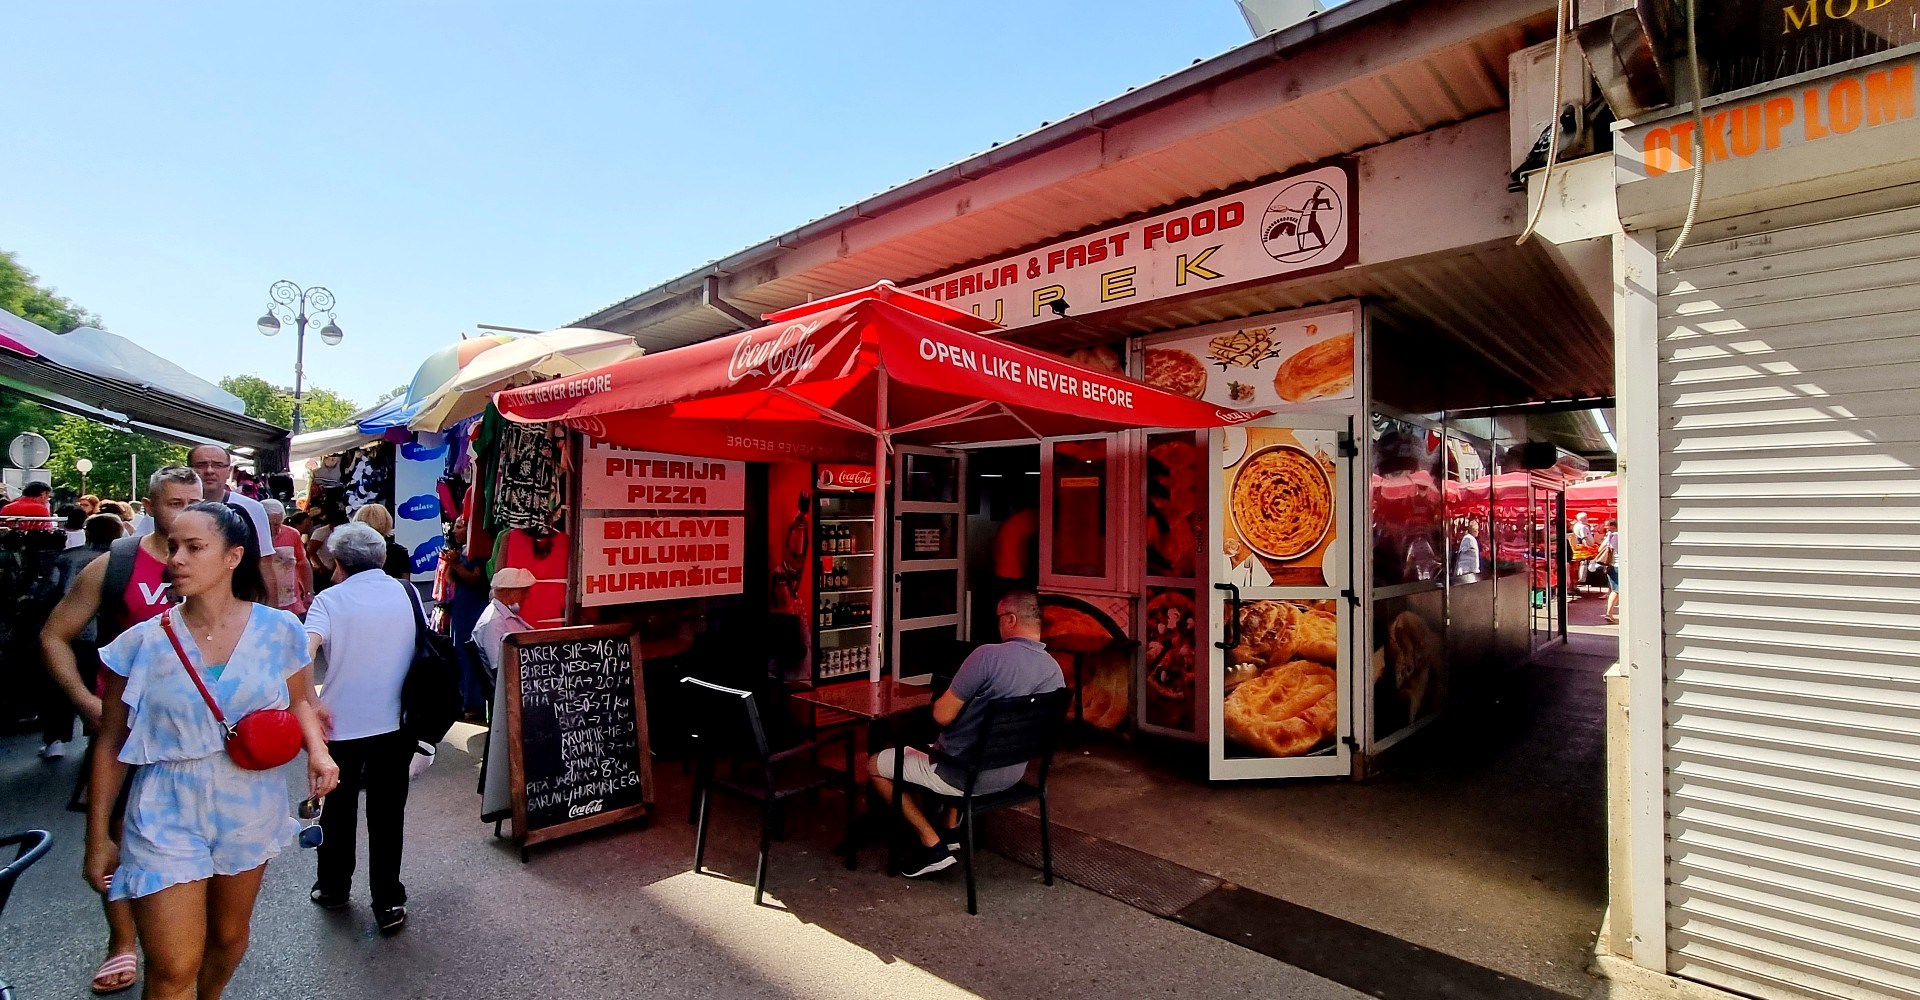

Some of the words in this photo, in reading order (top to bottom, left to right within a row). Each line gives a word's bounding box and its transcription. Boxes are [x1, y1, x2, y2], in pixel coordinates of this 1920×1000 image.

[1643, 96, 1795, 177] OTKUP
[1804, 64, 1915, 141] LOM
[1026, 257, 1042, 280] &
[1048, 231, 1130, 275] FAST
[1143, 201, 1245, 251] FOOD
[919, 337, 978, 372] OPEN
[982, 354, 1022, 384] LIKE
[1026, 366, 1078, 397] NEVER
[1082, 382, 1134, 409] BEFORE
[535, 383, 566, 403] NEVER
[568, 373, 612, 398] BEFORE
[606, 458, 726, 480] PITERIJA
[628, 485, 707, 504] PIZZA
[604, 520, 729, 539] BAKLAVE
[603, 544, 729, 566] TULUMBE
[586, 566, 742, 594] HURMAŠICE
[520, 646, 559, 664] BUREK
[562, 643, 582, 659] SIR
[597, 639, 613, 660] 16
[520, 664, 556, 680] BUREK
[559, 661, 590, 678] MESO
[602, 657, 617, 676] 17
[595, 676, 614, 689] 20
[553, 698, 590, 718] MESO
[601, 694, 611, 710] 7
[555, 690, 578, 701] SIR
[601, 760, 611, 777] 8
